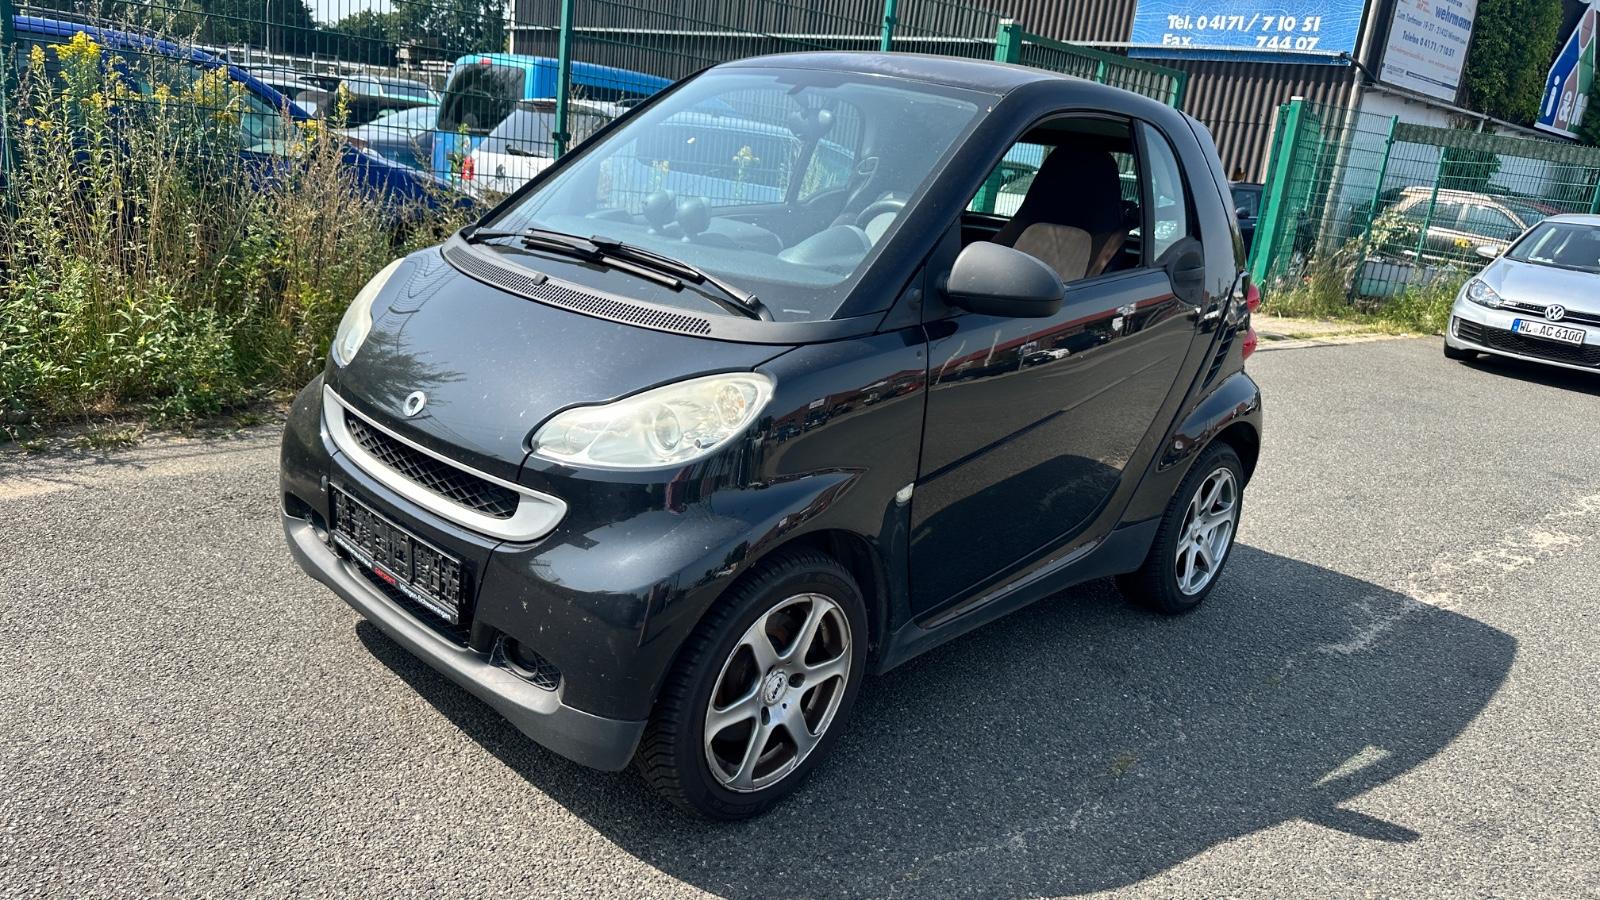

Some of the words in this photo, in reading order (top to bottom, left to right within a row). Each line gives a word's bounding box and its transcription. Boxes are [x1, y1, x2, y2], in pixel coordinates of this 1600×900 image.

[1168, 15, 1193, 30] Tel.
[1435, 5, 1472, 31] wehrmann
[1539, 325, 1554, 337] AC
[1555, 328, 1582, 342] 6100
